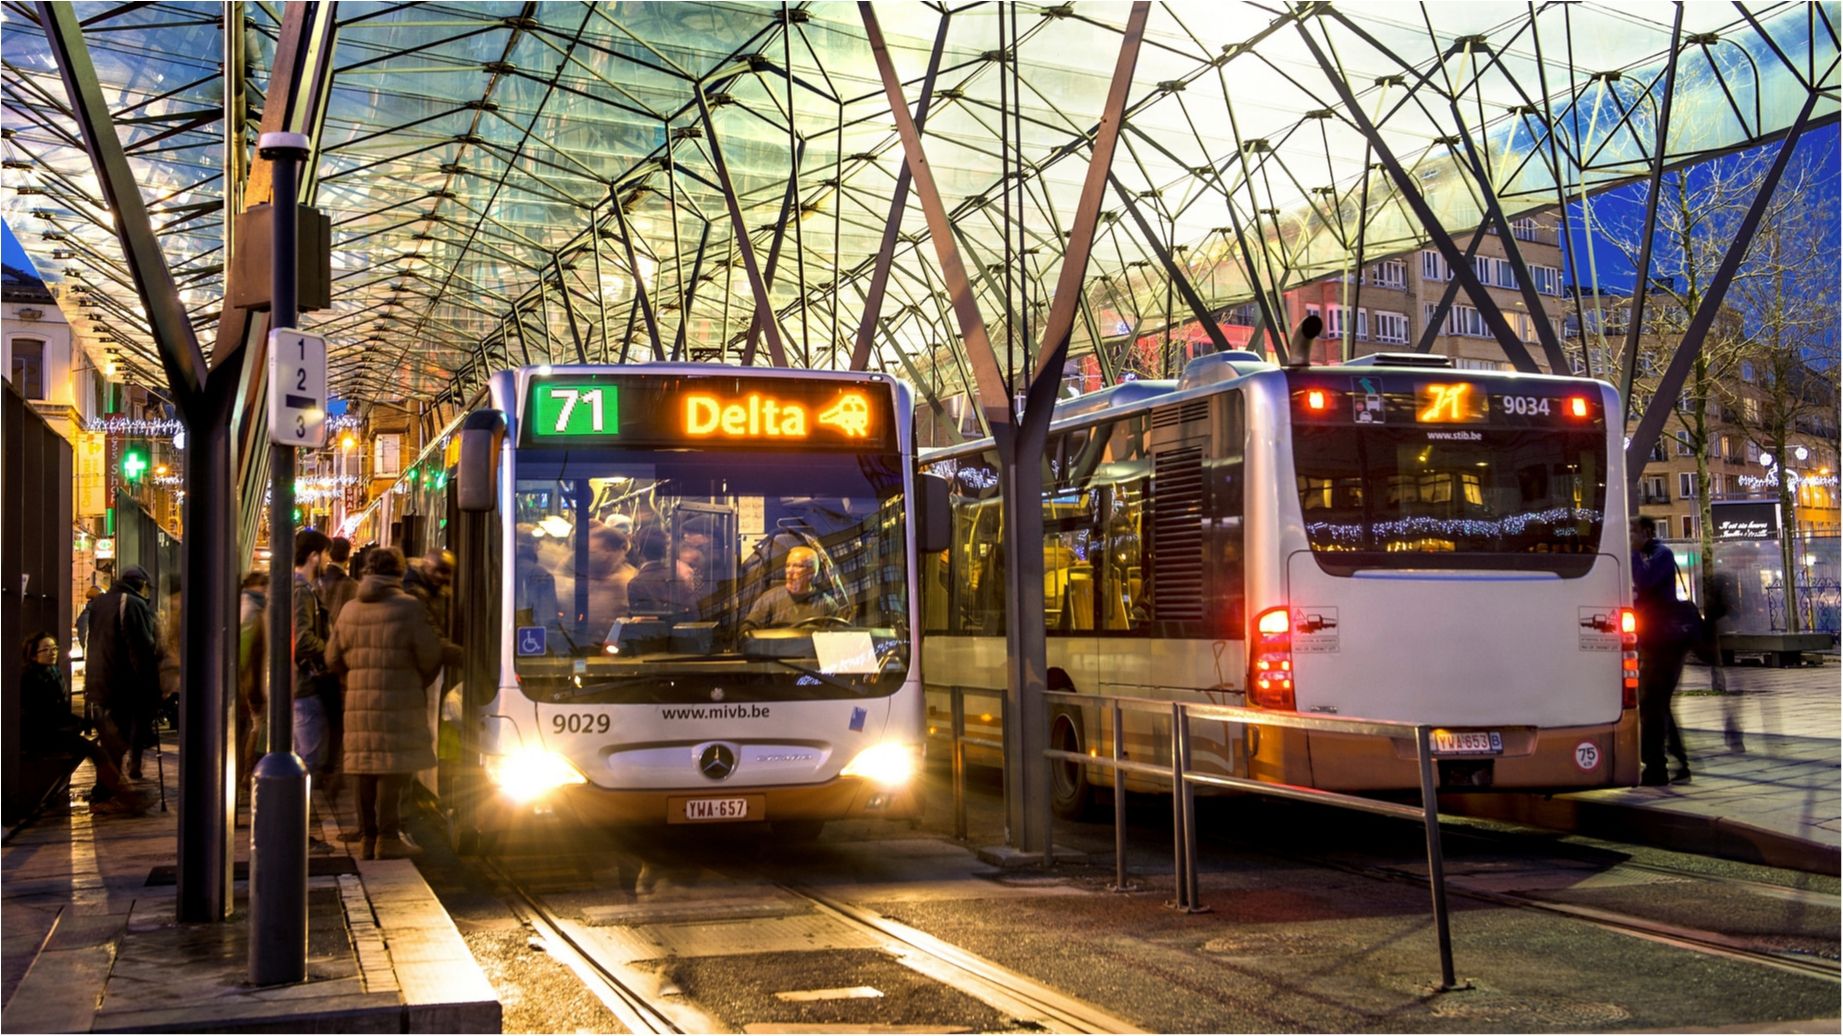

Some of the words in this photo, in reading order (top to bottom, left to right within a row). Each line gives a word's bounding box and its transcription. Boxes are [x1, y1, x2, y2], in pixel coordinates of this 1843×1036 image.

[297, 338, 305, 361] 1
[296, 367, 307, 391] 2
[550, 388, 604, 433] 71
[686, 394, 807, 436] Delta
[1421, 383, 1470, 421] 71
[1502, 395, 1551, 416] 9034
[295, 414, 306, 439] 3
[1427, 431, 1482, 441] www.stib.be
[552, 713, 611, 735] 9029
[661, 704, 770, 720] www.mivb.be
[1491, 734, 1501, 747] B
[1577, 746, 1596, 762] 75
